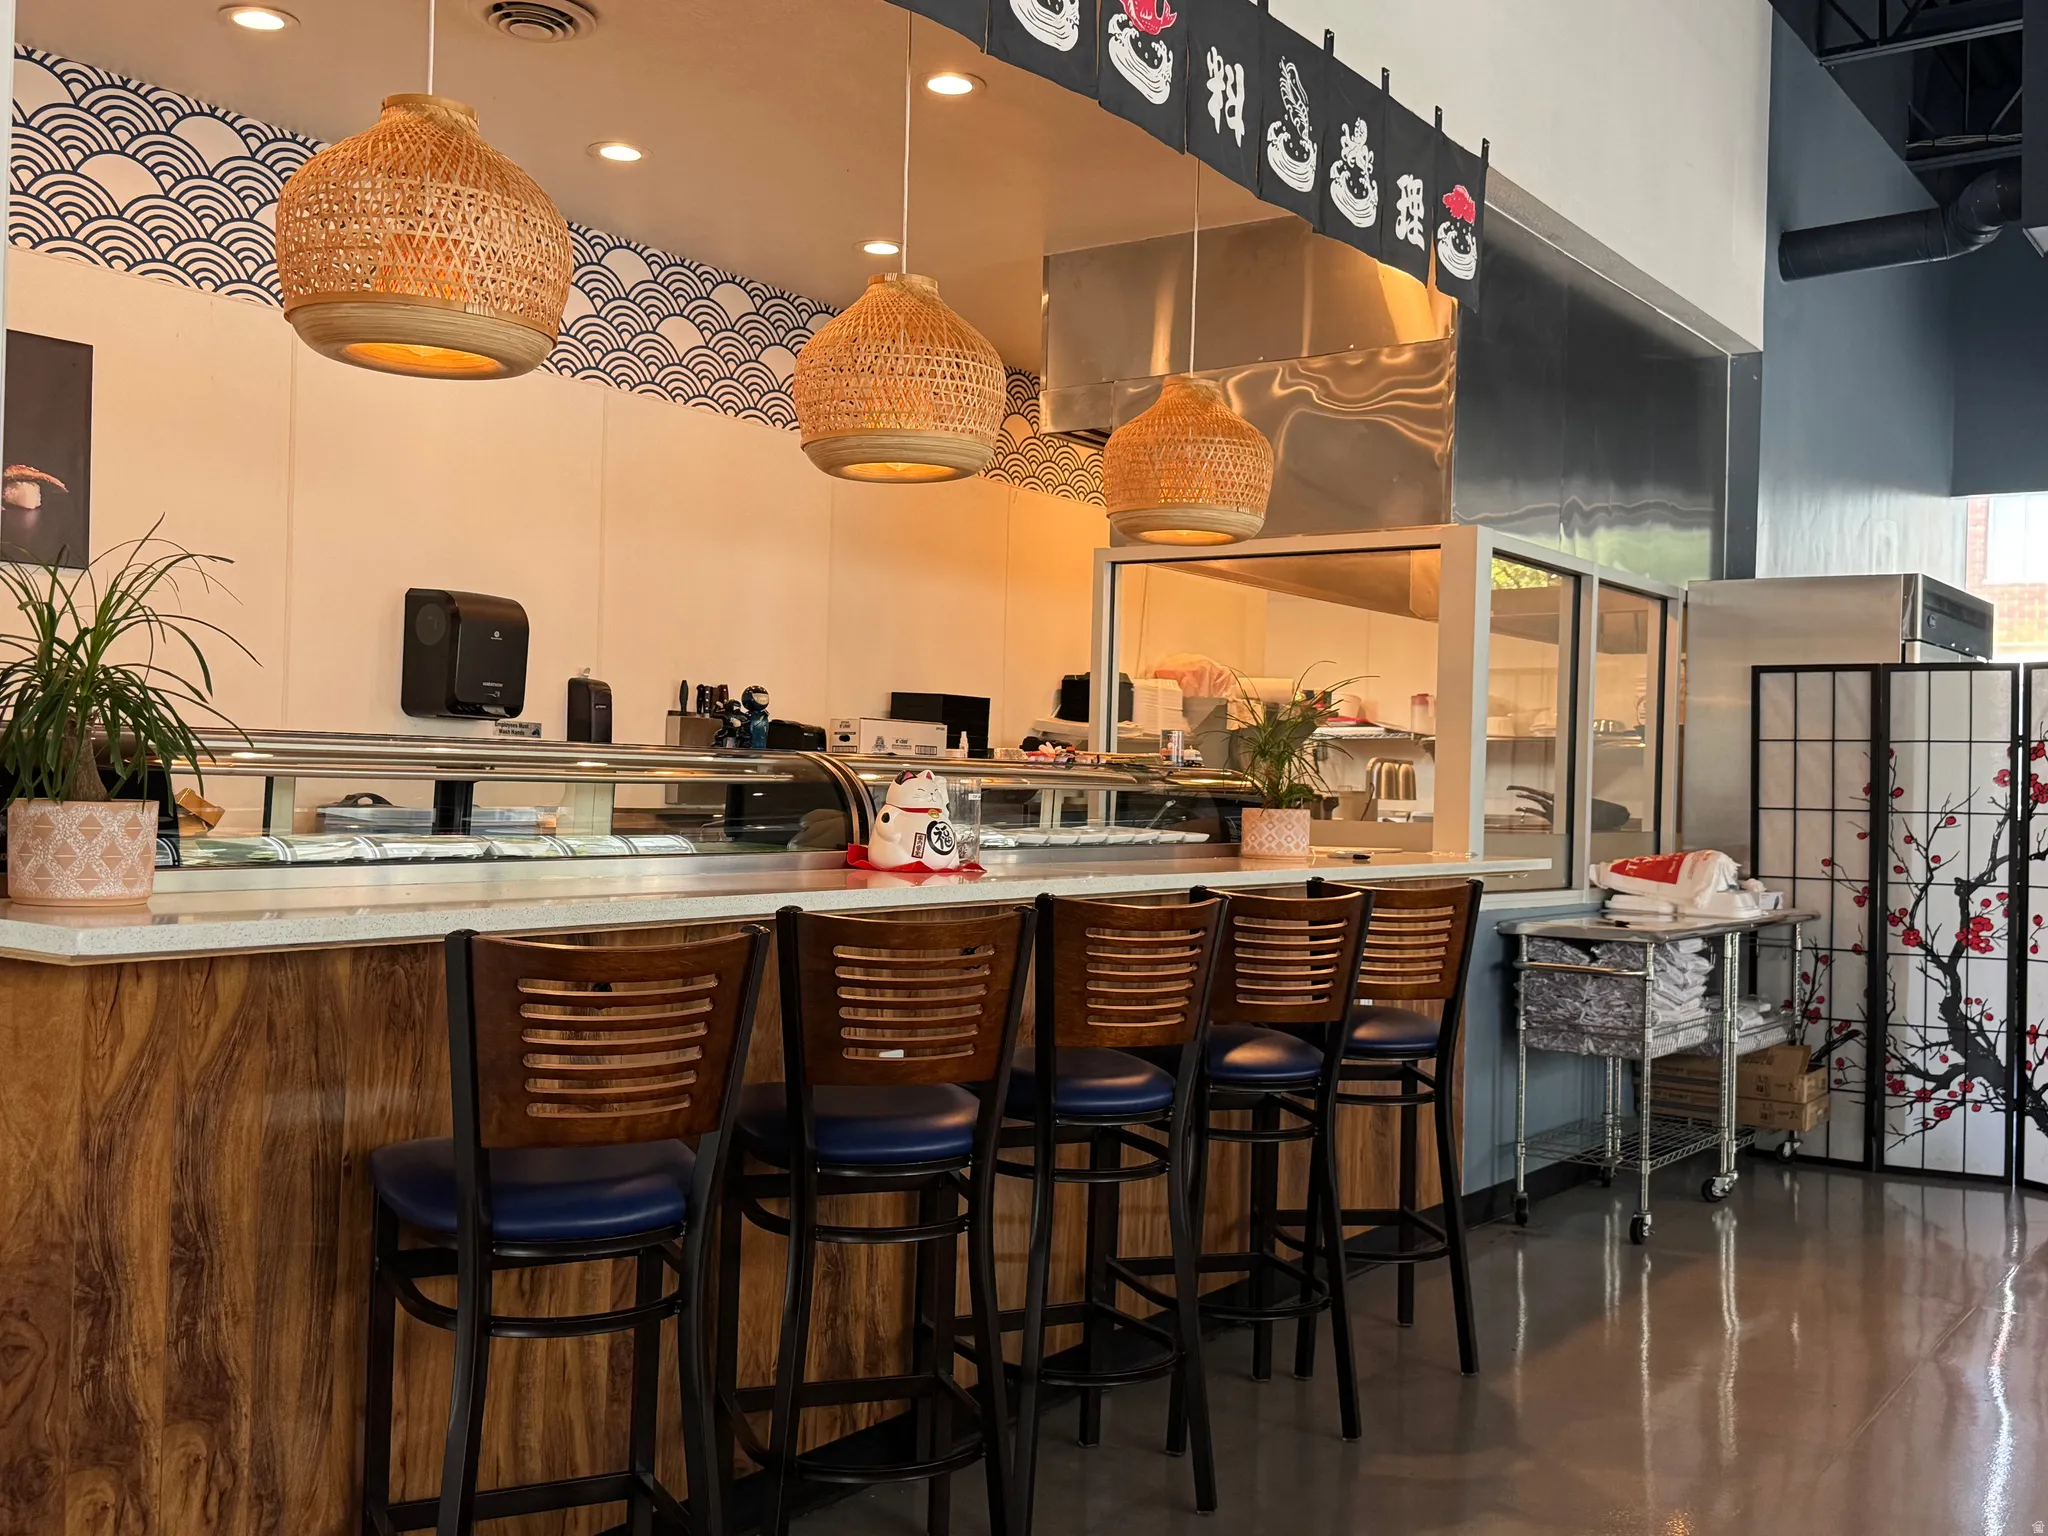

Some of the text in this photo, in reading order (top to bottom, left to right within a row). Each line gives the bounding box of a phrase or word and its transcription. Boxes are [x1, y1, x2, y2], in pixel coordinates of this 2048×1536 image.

[1395, 174, 1425, 251] 理
[494, 721, 518, 729] Employees
[933, 825, 953, 850] 福
